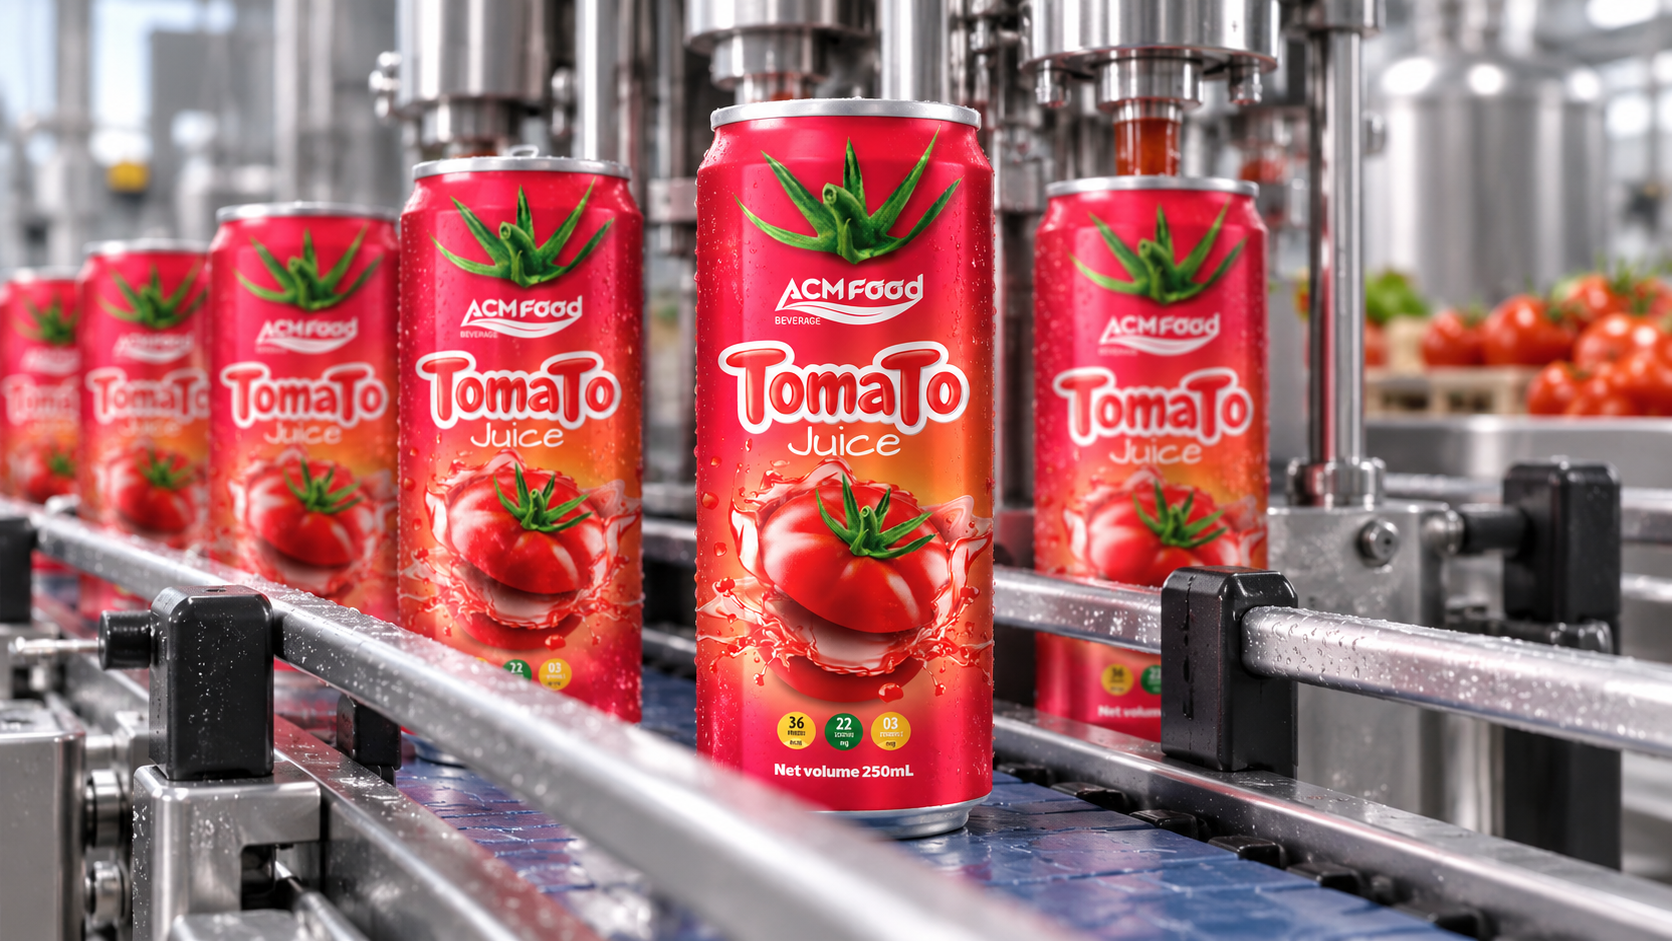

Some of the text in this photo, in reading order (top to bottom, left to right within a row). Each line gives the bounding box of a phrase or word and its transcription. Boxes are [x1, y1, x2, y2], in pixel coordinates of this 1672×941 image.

[775, 316, 821, 325] BEVERAGE
[263, 421, 342, 445] Juice
[470, 422, 564, 447] Juice
[788, 426, 901, 456] Juice
[1109, 438, 1202, 464] Juice
[548, 662, 561, 673] 03
[1123, 706, 1161, 718] volum
[789, 716, 804, 729] 36
[836, 717, 852, 730] 22
[883, 717, 898, 730] 03
[774, 763, 914, 778] Net volume 250mL
